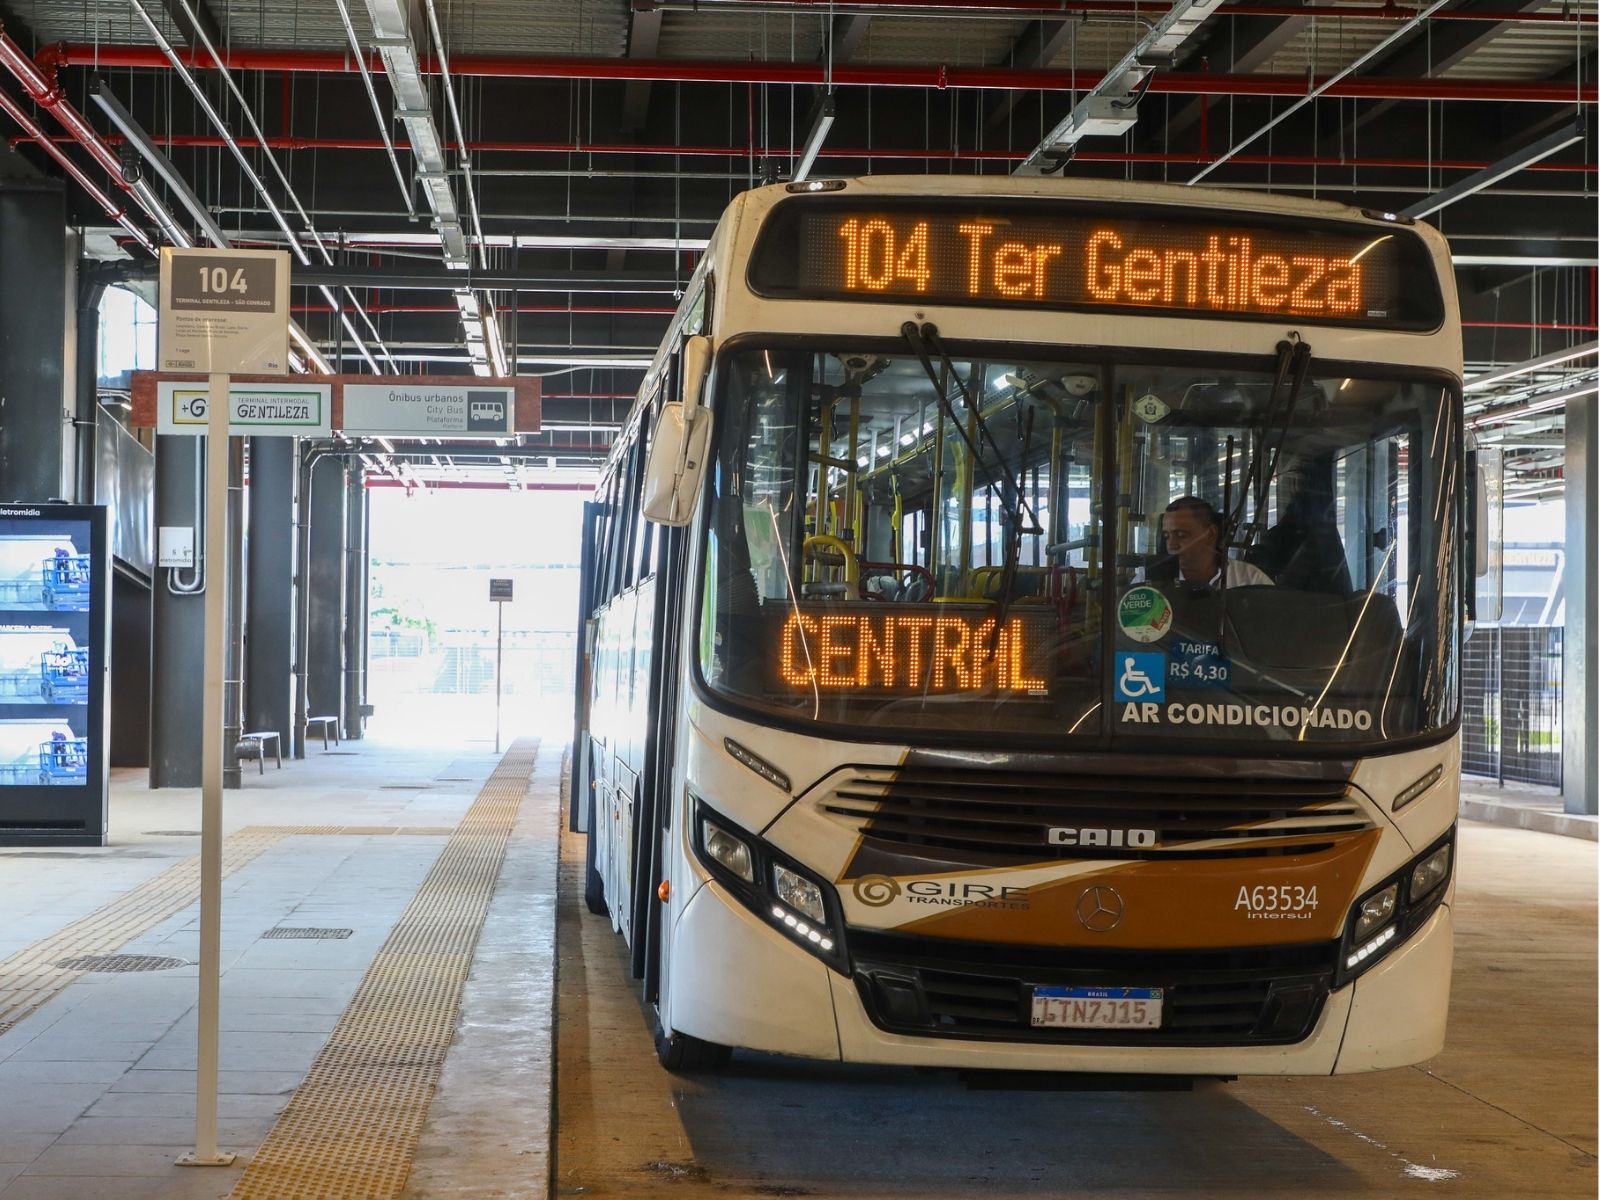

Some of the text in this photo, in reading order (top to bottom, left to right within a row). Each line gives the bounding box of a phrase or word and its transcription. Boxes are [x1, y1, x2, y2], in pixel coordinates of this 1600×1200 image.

[839, 219, 1360, 310] 104 Ter Gentileza
[199, 267, 248, 294] 104
[388, 391, 464, 404] Ônibus urbanos
[237, 404, 310, 420] GENTILEZA
[426, 405, 464, 415] City Bus
[426, 416, 464, 424] Plataforma
[0, 508, 41, 517] letromidia
[1123, 599, 1152, 609] VERDE
[1128, 593, 1147, 601] SELO
[782, 614, 1045, 689] CENTRAL
[1179, 642, 1219, 655] TARIFA
[1170, 661, 1227, 681] R$ 4,30
[1121, 702, 1372, 731] AR CONDICIONADO
[1048, 827, 1156, 847] CAIO
[906, 881, 1029, 901] GIRE
[1234, 885, 1319, 911] A63534
[906, 895, 1031, 911] TRANSPORTES
